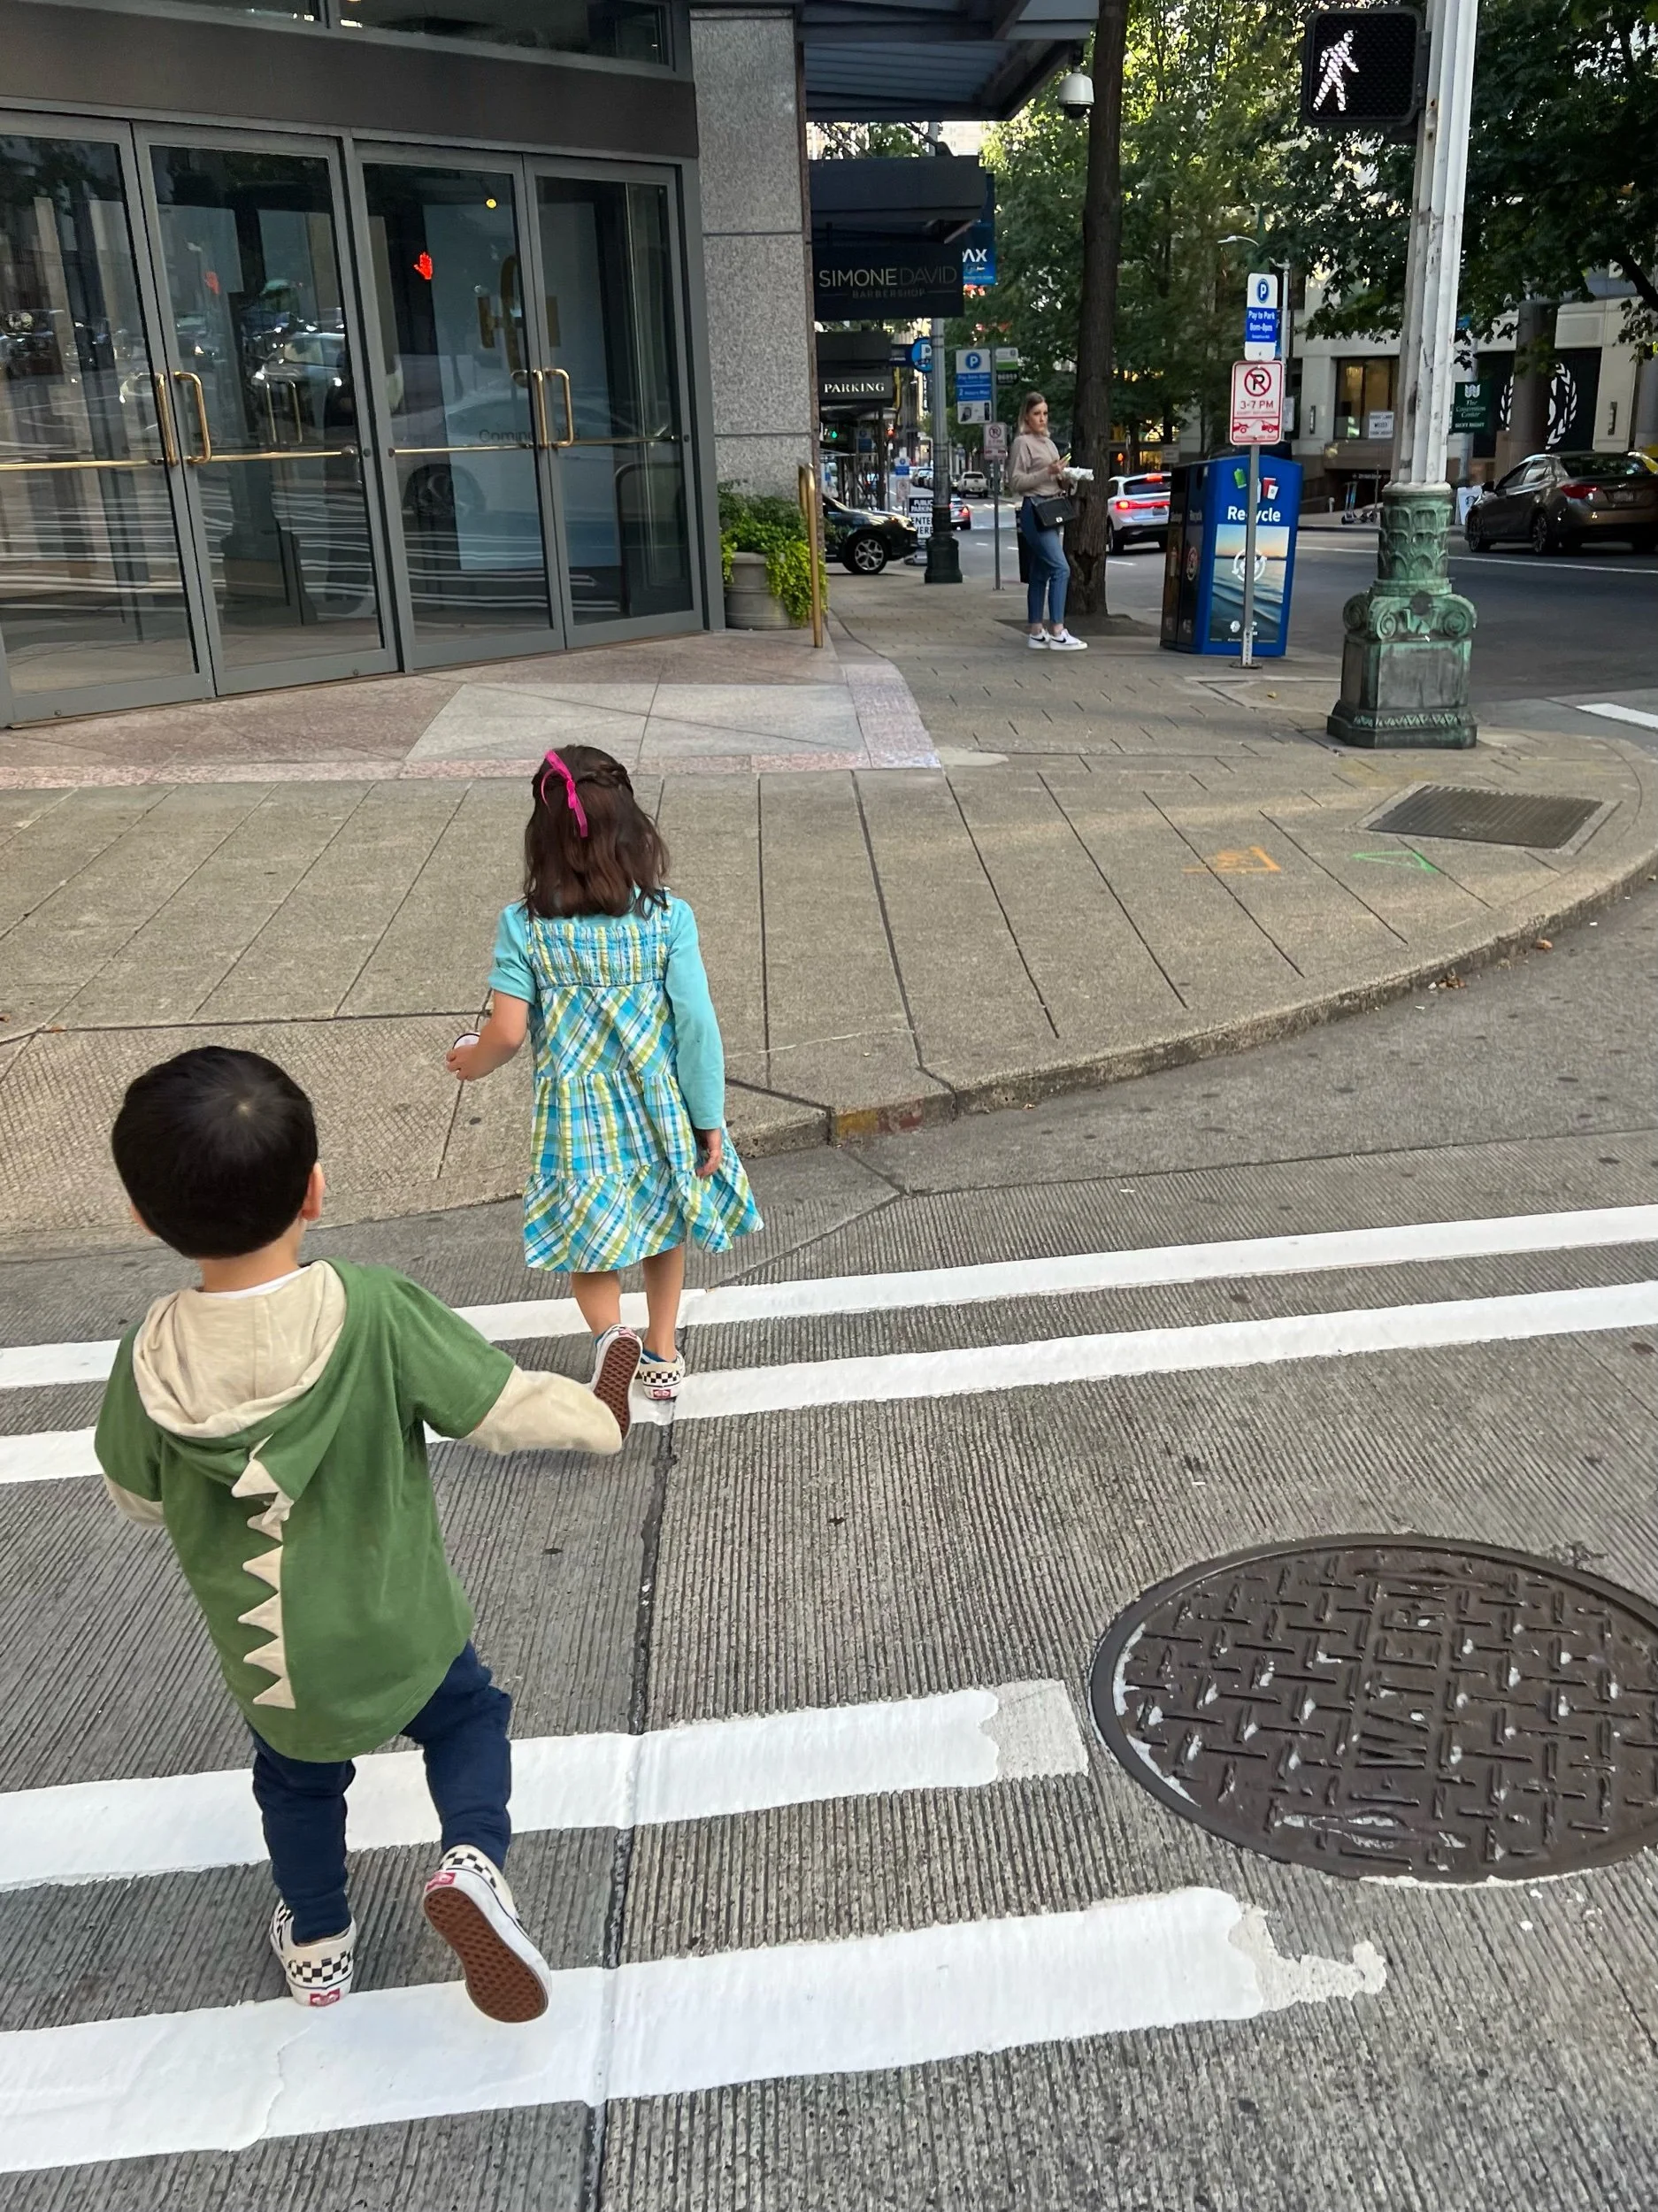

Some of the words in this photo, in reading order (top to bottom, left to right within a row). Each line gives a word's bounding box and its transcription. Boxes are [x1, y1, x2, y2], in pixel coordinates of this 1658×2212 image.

[963, 249, 987, 263] AX
[852, 288, 925, 299] BARBERSHOP
[1248, 311, 1257, 320] Pay
[824, 382, 885, 393] PARKING
[1240, 401, 1256, 410] 3-7
[1259, 400, 1274, 409] PM
[1227, 505, 1281, 524] Reycle
